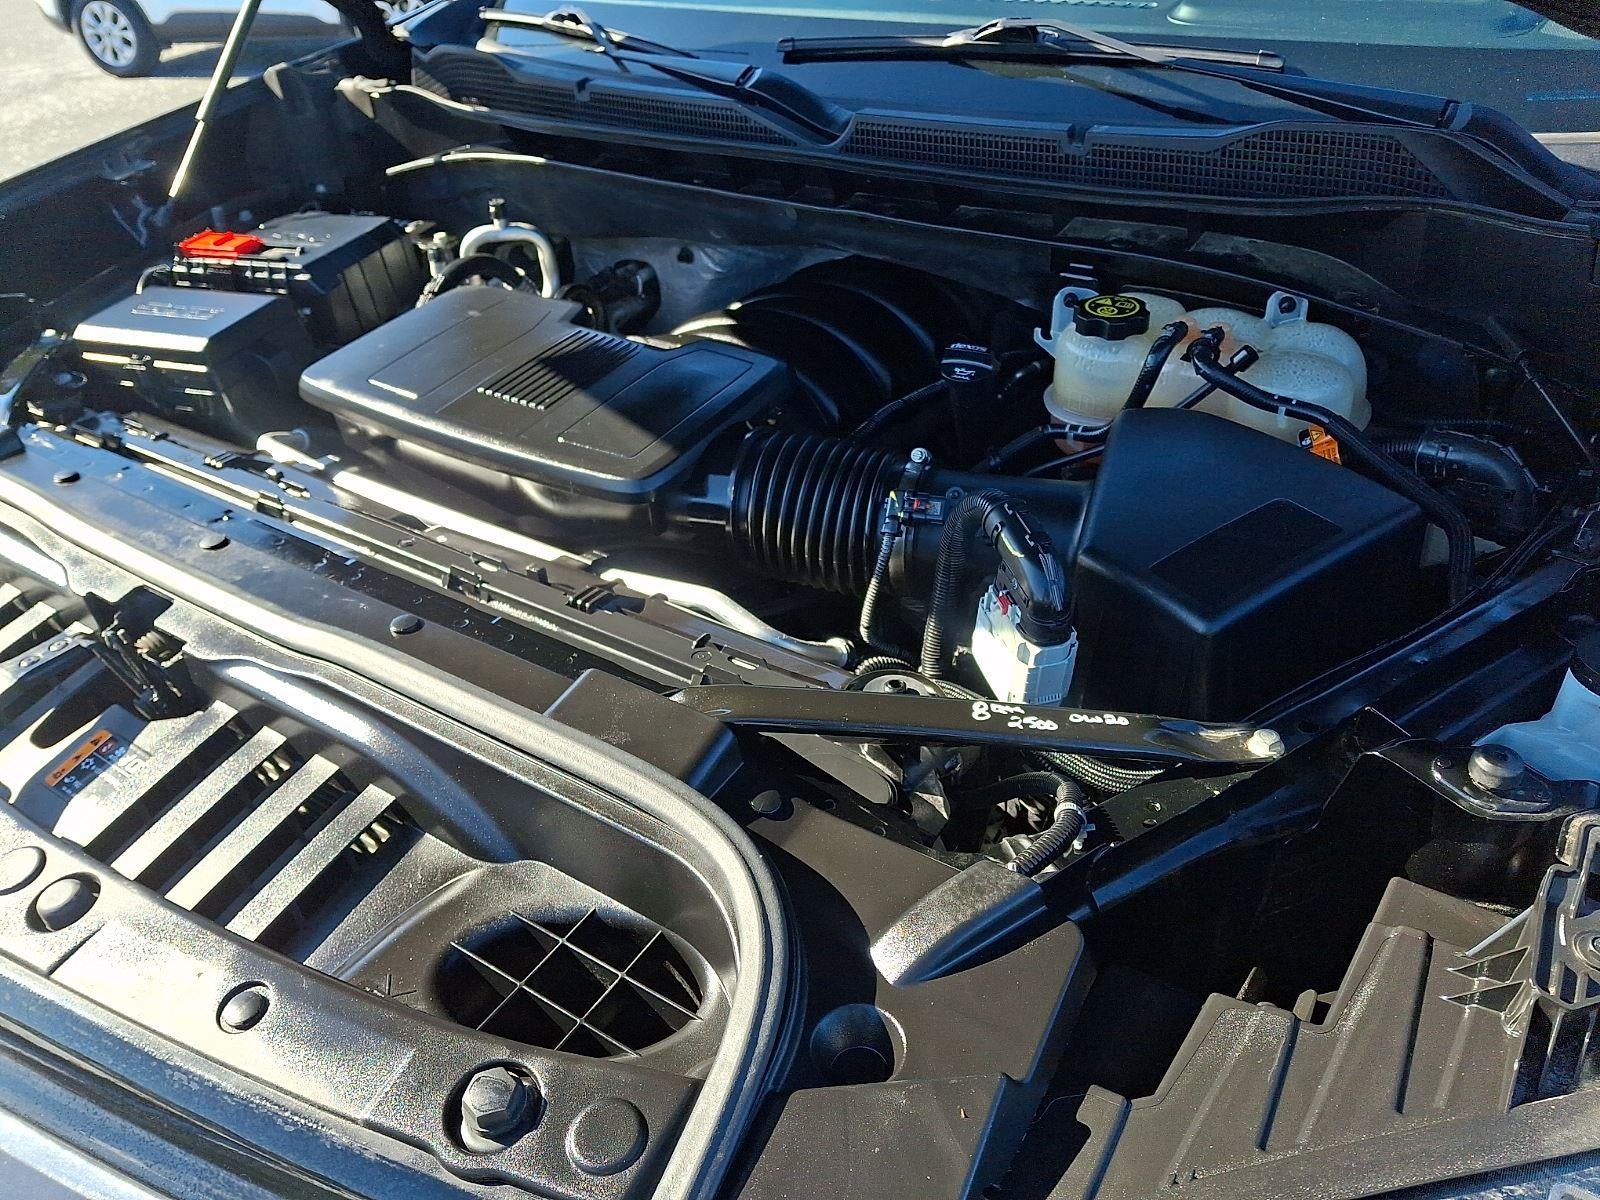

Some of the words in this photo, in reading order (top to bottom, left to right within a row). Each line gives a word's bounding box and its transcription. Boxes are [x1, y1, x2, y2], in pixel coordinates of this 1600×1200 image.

[950, 342, 988, 353] dexos
[971, 701, 992, 721] 8
[1007, 715, 1059, 731] 2500
